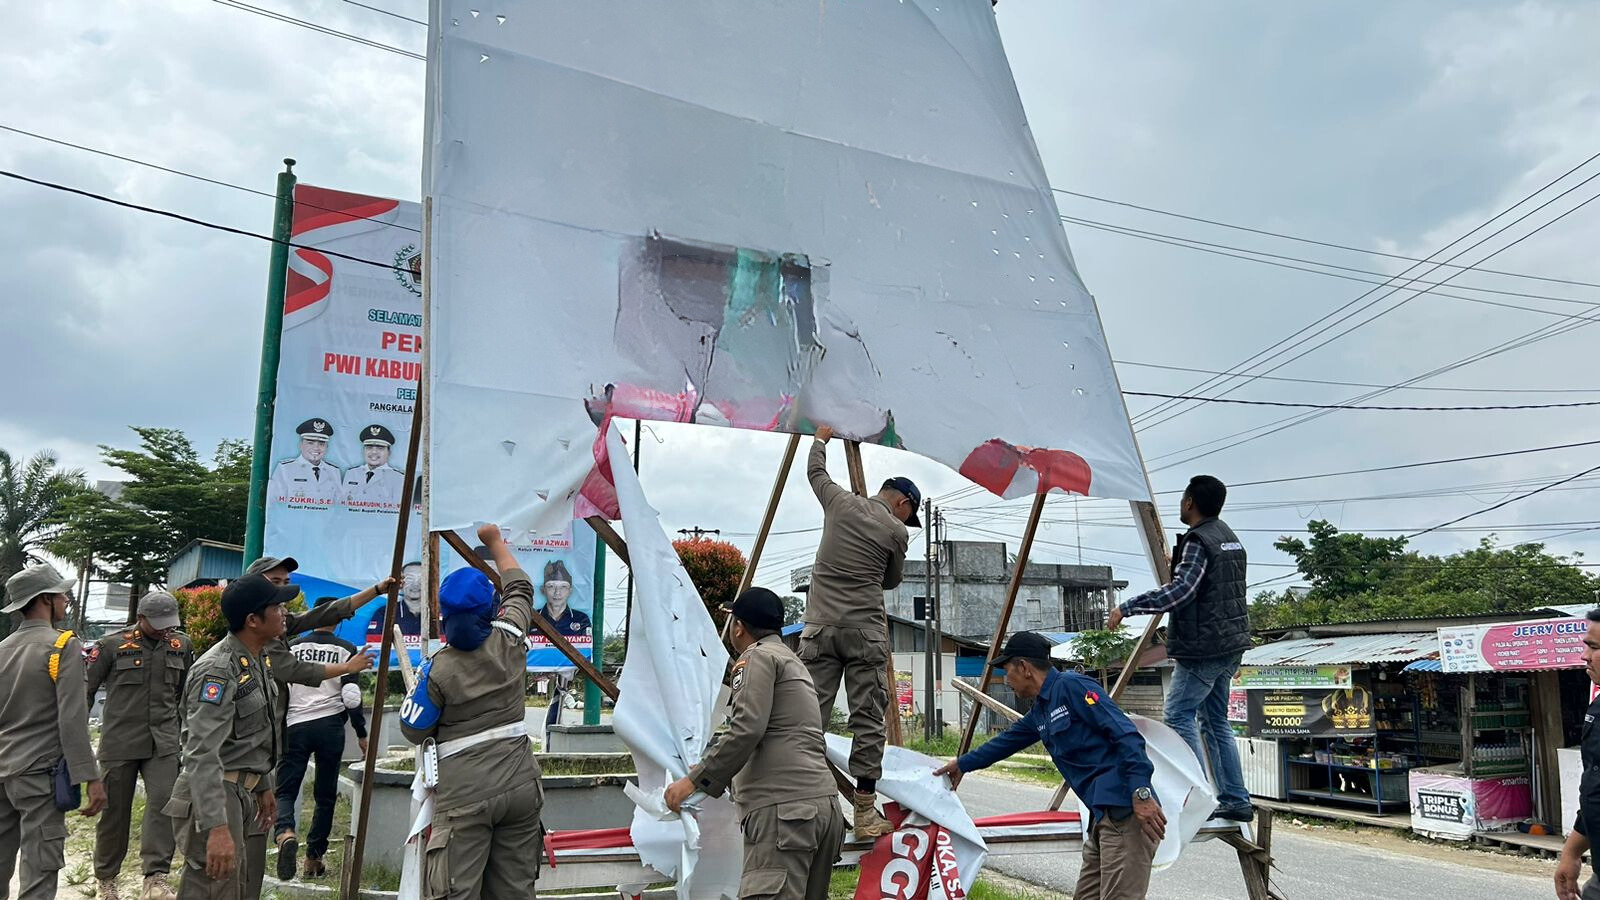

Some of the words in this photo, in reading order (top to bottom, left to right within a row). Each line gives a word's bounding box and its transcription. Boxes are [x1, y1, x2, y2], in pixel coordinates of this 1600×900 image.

[368, 309, 422, 327] SELAMAT
[323, 352, 361, 375] PWI
[369, 402, 413, 413] PANGKALA
[1513, 624, 1553, 637] JEFRY
[1555, 622, 1588, 634] CELL
[1420, 795, 1458, 807] TRIPLE
[1423, 803, 1459, 816] BONUS
